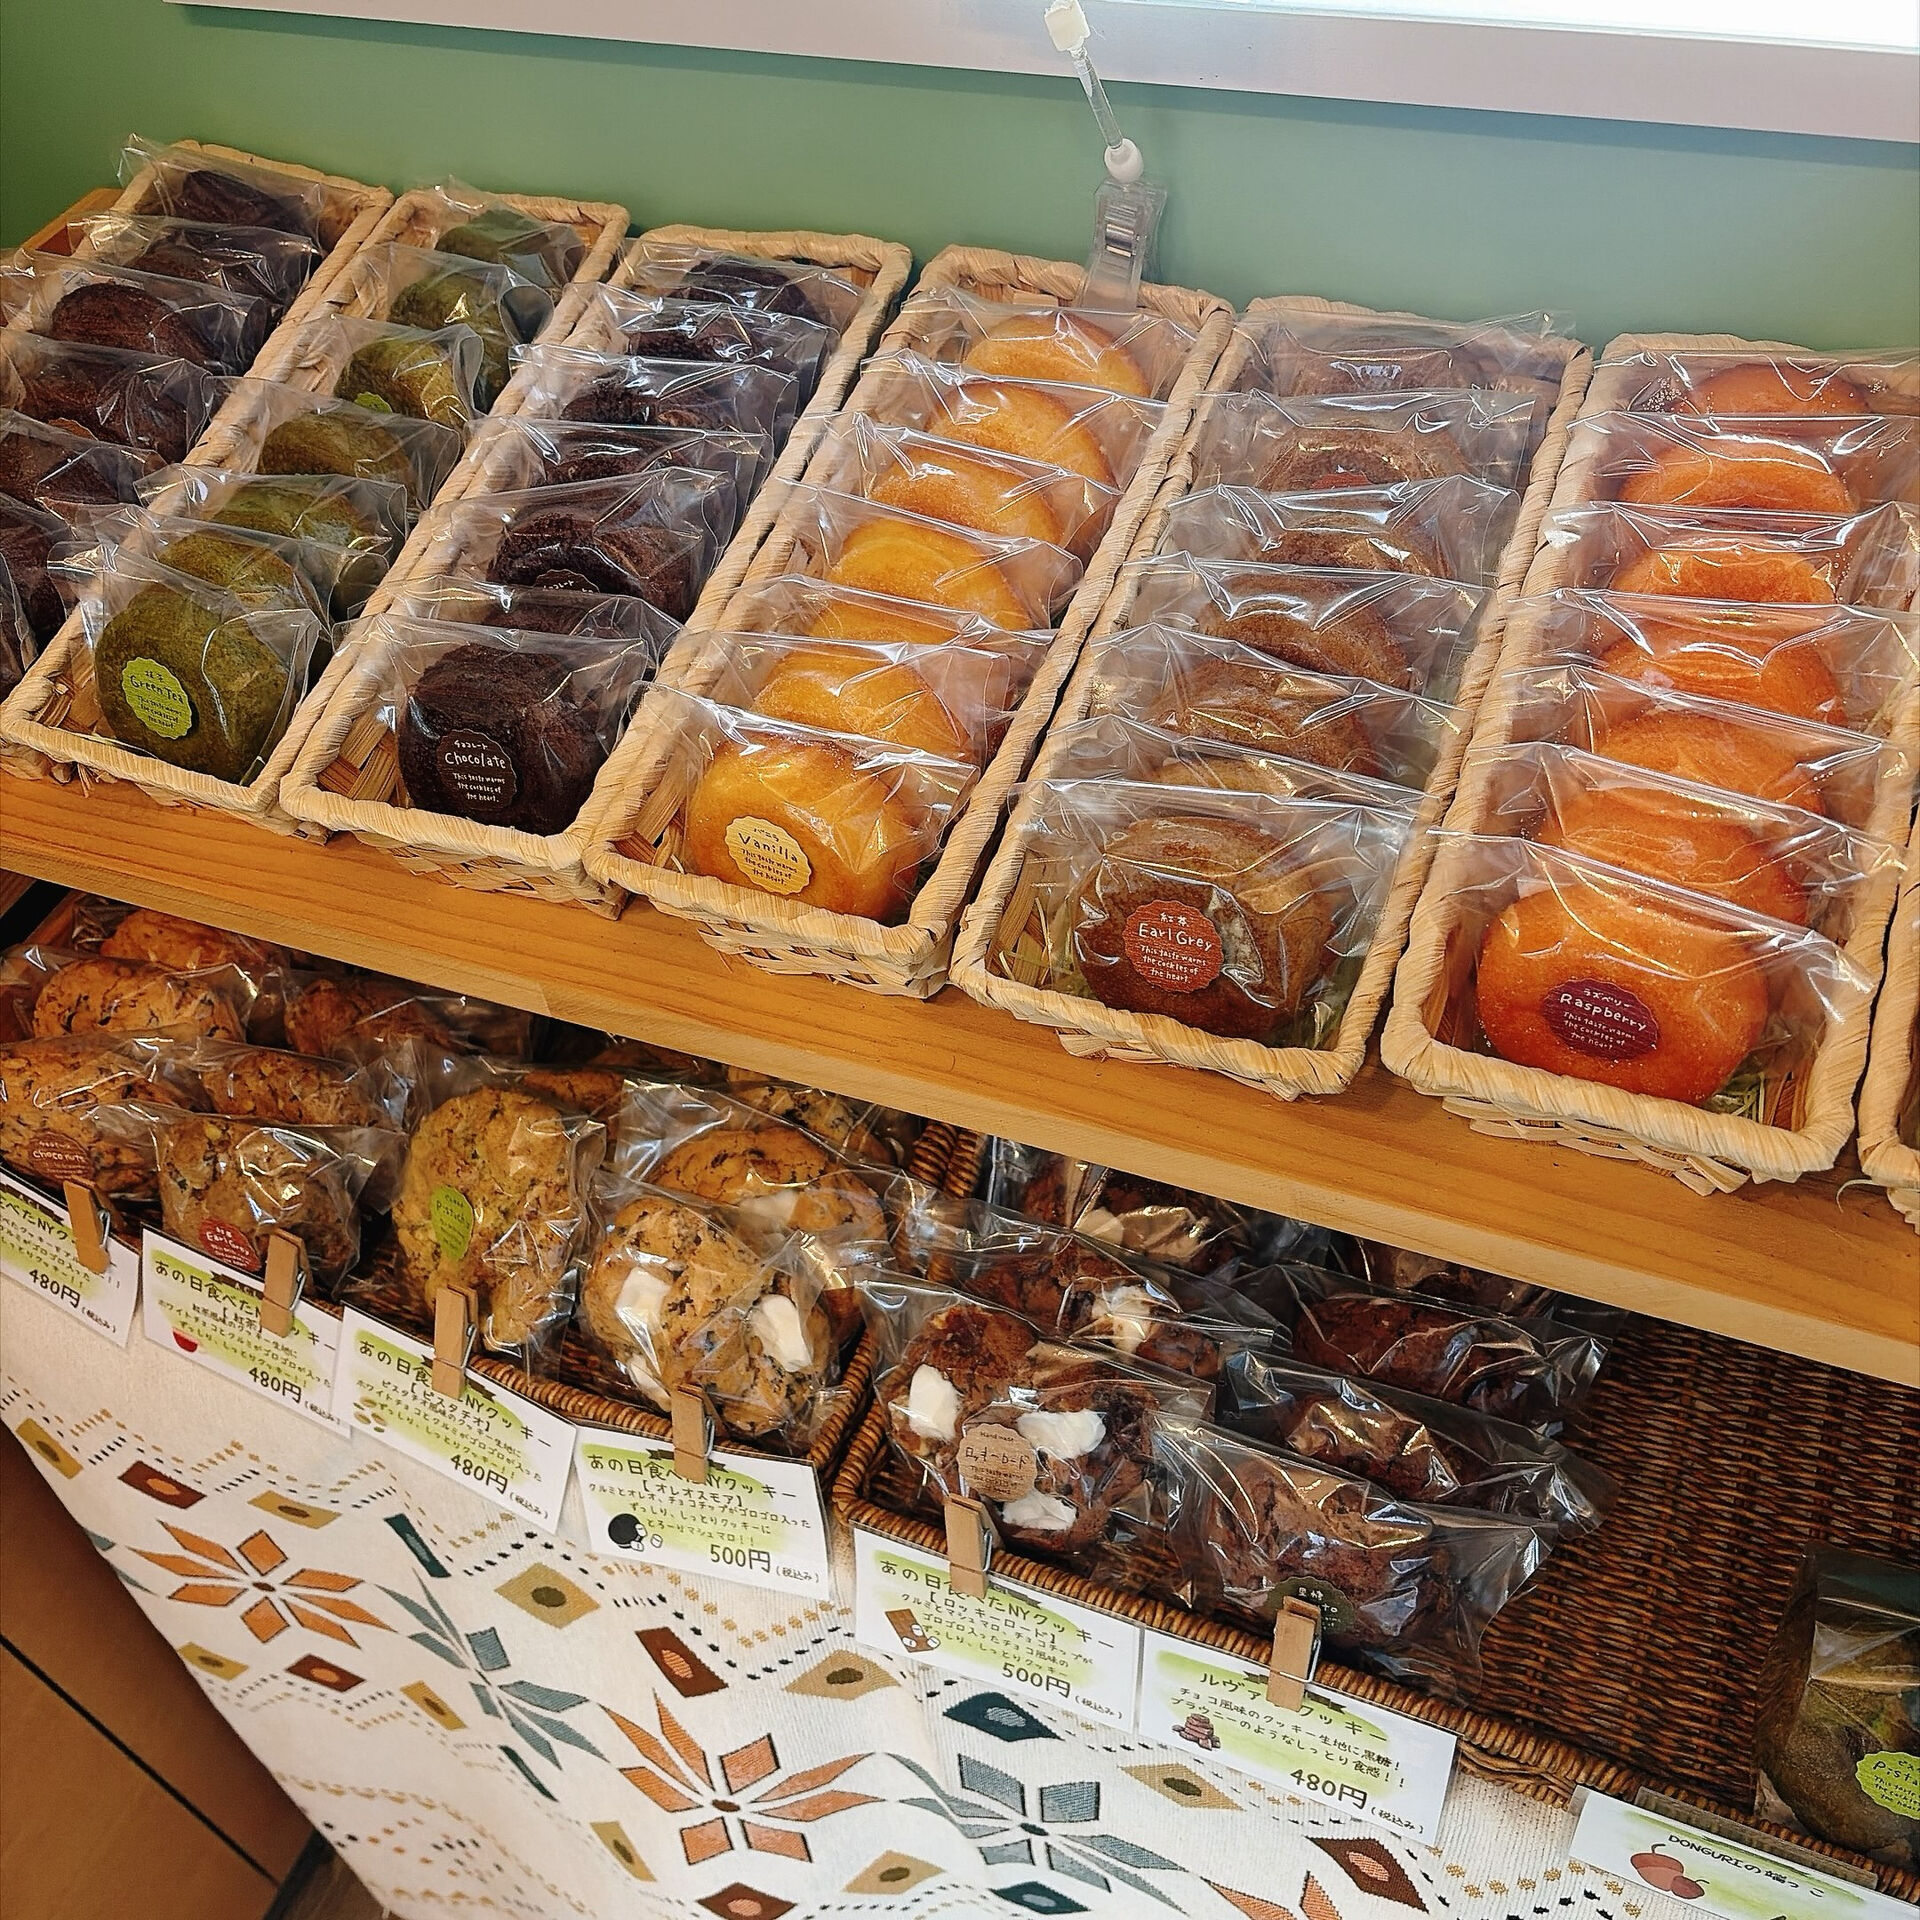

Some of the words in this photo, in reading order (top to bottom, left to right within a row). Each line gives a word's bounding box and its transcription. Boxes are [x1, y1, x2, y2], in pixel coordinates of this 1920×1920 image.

[130, 675, 163, 695] Green
[164, 687, 184, 704] Tea
[444, 751, 506, 769] Chocolate
[452, 772, 467, 780] This
[738, 832, 798, 863] Vanilla
[742, 848, 756, 858] This
[1138, 922, 1172, 941] Earl
[1176, 931, 1212, 951] Grey
[1140, 944, 1157, 954] This
[1160, 949, 1179, 960] taste
[1182, 956, 1206, 966] warms
[1142, 955, 1155, 964] the
[1157, 960, 1188, 973] cockles
[1190, 967, 1199, 975] of
[1151, 968, 1164, 977] the
[1559, 993, 1647, 1031] Raspberry
[1563, 1011, 1581, 1022] This
[1583, 1018, 1607, 1030] taste
[1609, 1028, 1636, 1041] warms
[1571, 1032, 1585, 1041] the
[29, 1268, 81, 1309] 480円
[249, 1366, 302, 1404] 480円
[410, 1382, 490, 1432] 【ピスタチオ】
[965, 1446, 1030, 1470] ロッキーロード
[450, 1454, 508, 1495] 480円
[588, 1483, 812, 1529] クルミとオレオ、チョコチップがゴロゴロ入った
[642, 1479, 743, 1507] 【オレオスモア】
[710, 1544, 771, 1574] 500円
[930, 1591, 1056, 1644] 【ロッキーロード】
[1002, 1662, 1071, 1698] 500円
[1200, 1672, 1387, 1742] ルヴァクッキー
[1171, 1697, 1405, 1788] ブラウニーのようなしっとり食感！！
[1180, 1687, 1401, 1771] チョコ風味のクッキー生地に黒糖！
[1290, 1769, 1368, 1809] 480円
[1371, 1806, 1425, 1834] （税込み）
[1668, 1834, 1825, 1898] DONGURIの端っこ
